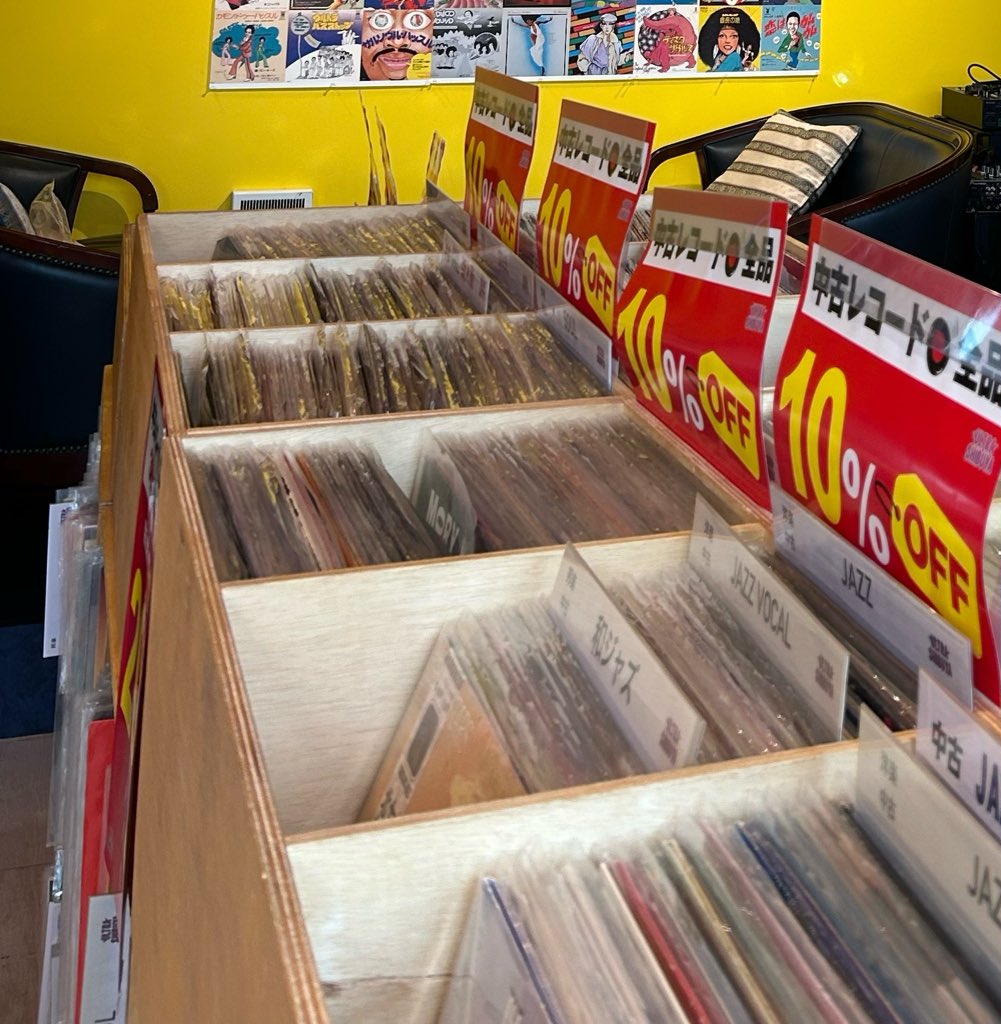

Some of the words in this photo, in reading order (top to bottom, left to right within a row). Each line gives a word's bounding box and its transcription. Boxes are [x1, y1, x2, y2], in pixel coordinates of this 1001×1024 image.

[539, 182, 581, 301] 10%
[588, 253, 612, 312] OFF
[617, 288, 704, 432] 10%
[706, 373, 752, 449] OFF
[779, 348, 890, 567] 10%
[903, 500, 970, 615] OFF
[730, 556, 756, 607] JAZZ
[756, 587, 792, 651] VOCAL
[841, 557, 874, 609] JAZZ
[931, 719, 965, 781] 中古
